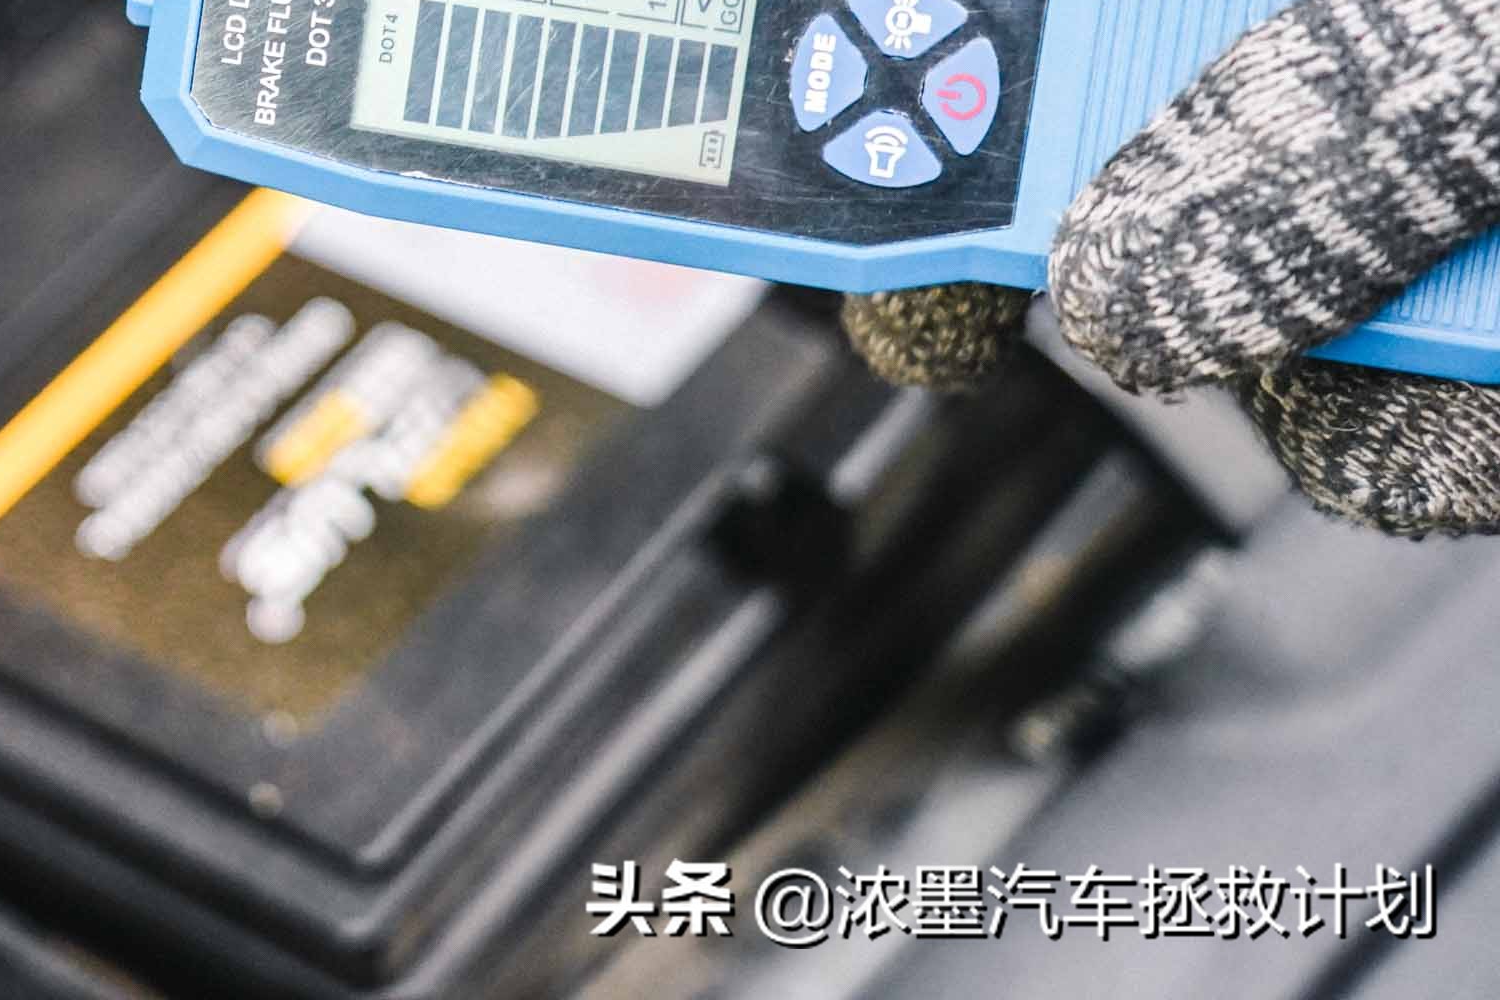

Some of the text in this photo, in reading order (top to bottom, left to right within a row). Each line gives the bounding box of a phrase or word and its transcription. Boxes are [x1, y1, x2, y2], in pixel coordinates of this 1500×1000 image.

[221, 13, 248, 66] LCD
[305, 10, 332, 67] DOT
[254, 37, 286, 126] BRAKE
[803, 33, 837, 114] MODE
